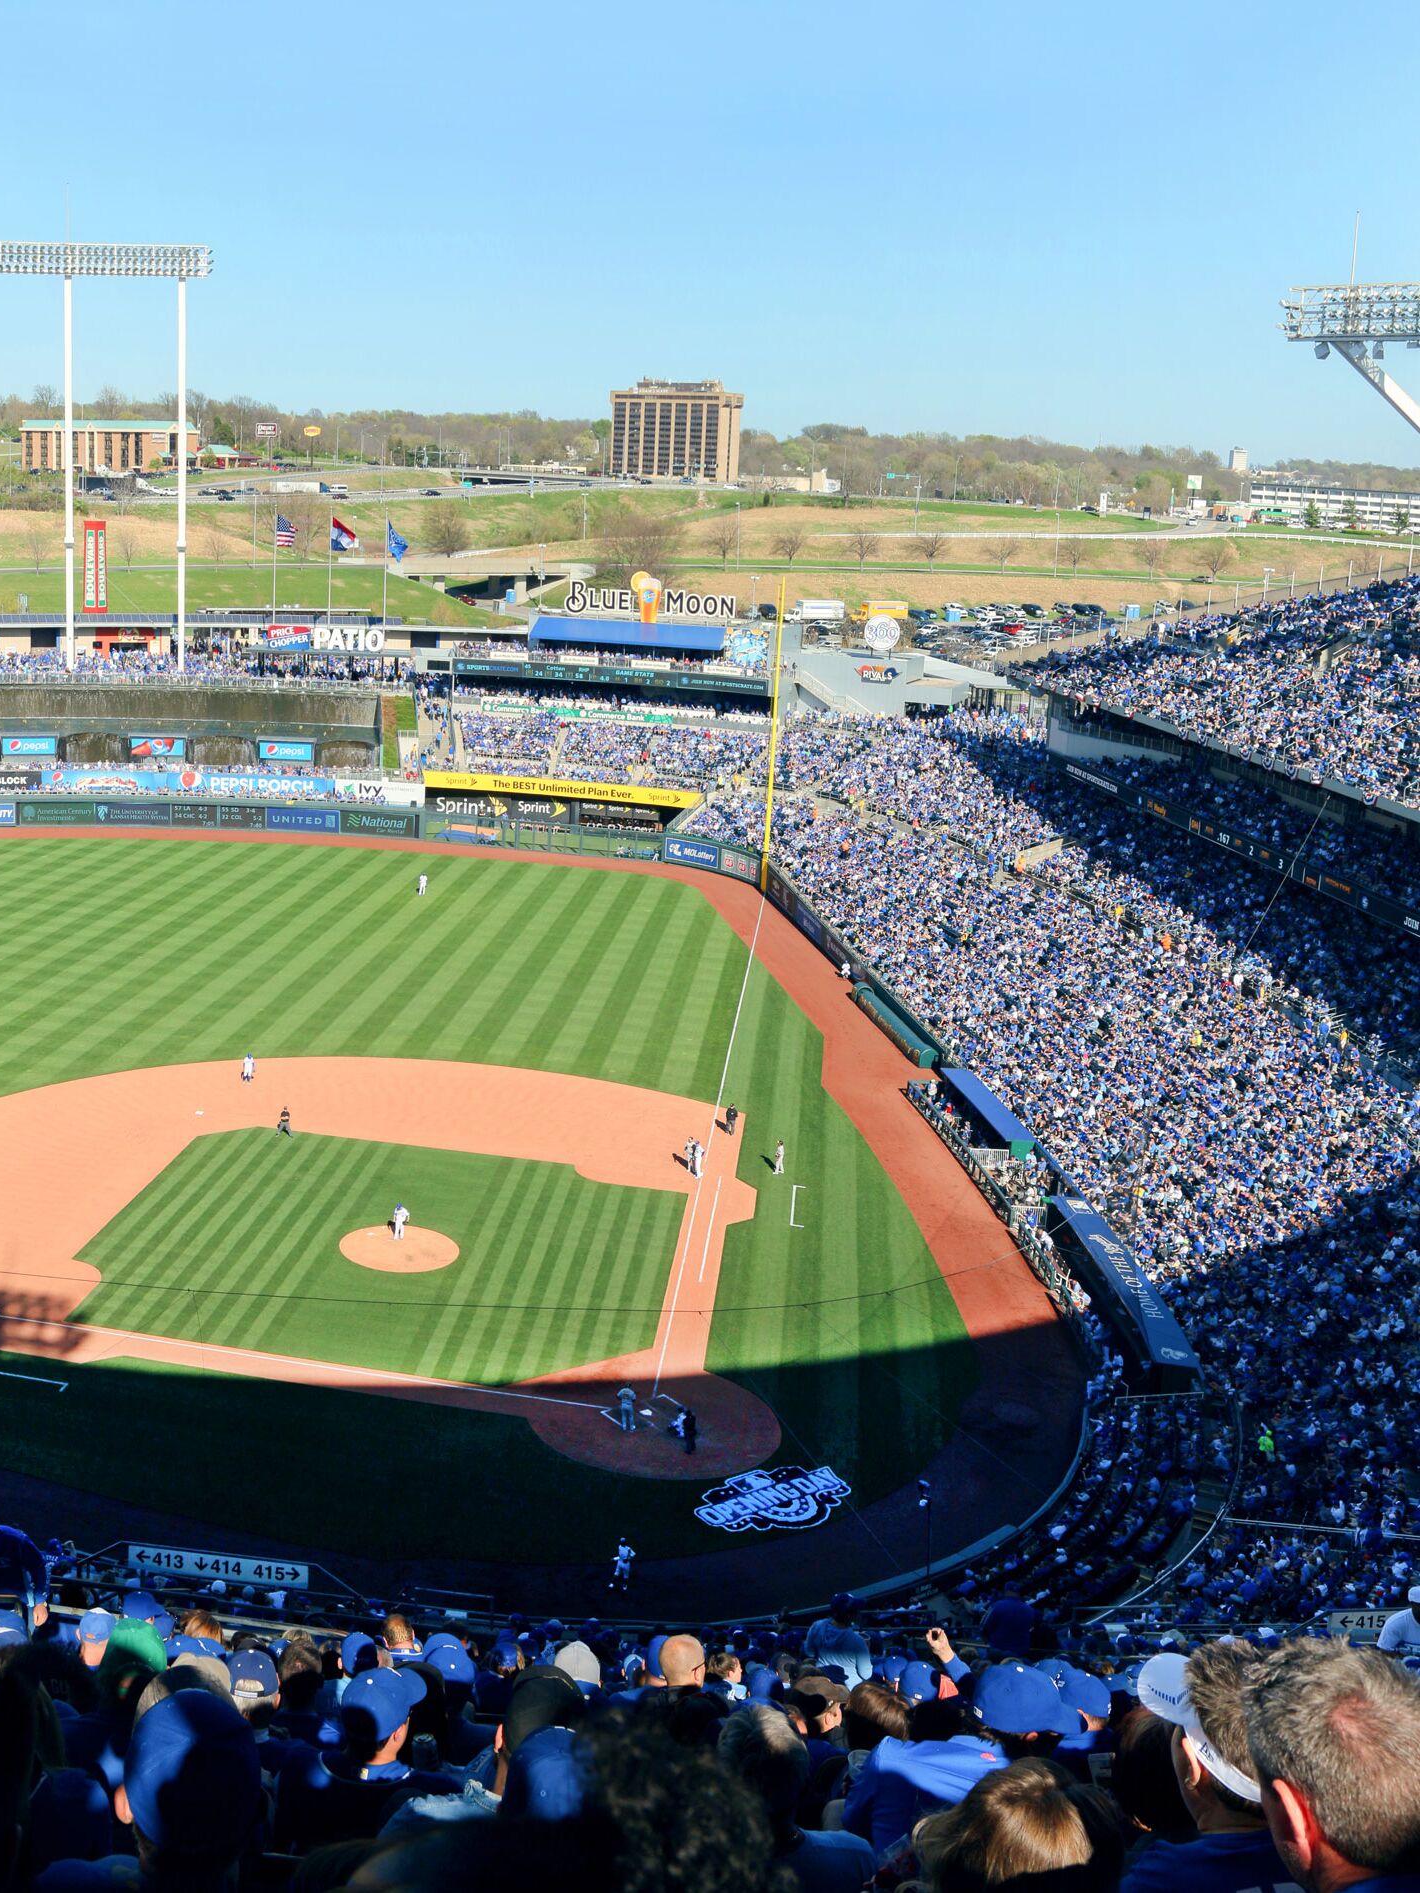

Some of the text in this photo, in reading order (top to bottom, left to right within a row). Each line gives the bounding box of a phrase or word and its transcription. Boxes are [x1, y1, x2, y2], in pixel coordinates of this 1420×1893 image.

[86, 536, 95, 598] BOULEVARD
[666, 590, 736, 618] MOON
[270, 626, 295, 638] PRICE
[866, 622, 898, 642] 360
[270, 635, 308, 648] CHOPPER
[314, 627, 386, 652] PATIO
[863, 670, 892, 680] RIVALS
[588, 710, 645, 722] Commerce Bank
[23, 740, 48, 752] pepsi
[280, 746, 304, 756] pepsi
[210, 776, 313, 792] PEPSI PORCH
[446, 777, 467, 786] Sprint
[359, 783, 382, 797] Ivy
[493, 780, 634, 800] The BEST Unlimited Plan Ever.
[648, 793, 670, 802] Sprint
[37, 808, 92, 817] American Century
[436, 797, 484, 815] Sprint
[518, 800, 550, 814] Sprint
[582, 802, 600, 810] Sprint
[272, 815, 322, 825] UNITED
[360, 815, 407, 830] National
[1217, 832, 1230, 844] .167
[684, 847, 716, 863] MOLottery
[1249, 846, 1254, 856] 2
[1278, 858, 1284, 870] 3
[1404, 916, 1420, 930] JOIN
[1108, 1254, 1164, 1319] HOME OF THE
[698, 1468, 840, 1524] OPENING DAY
[152, 1552, 285, 1581] 413 414 415
[1356, 1616, 1386, 1628] 415
